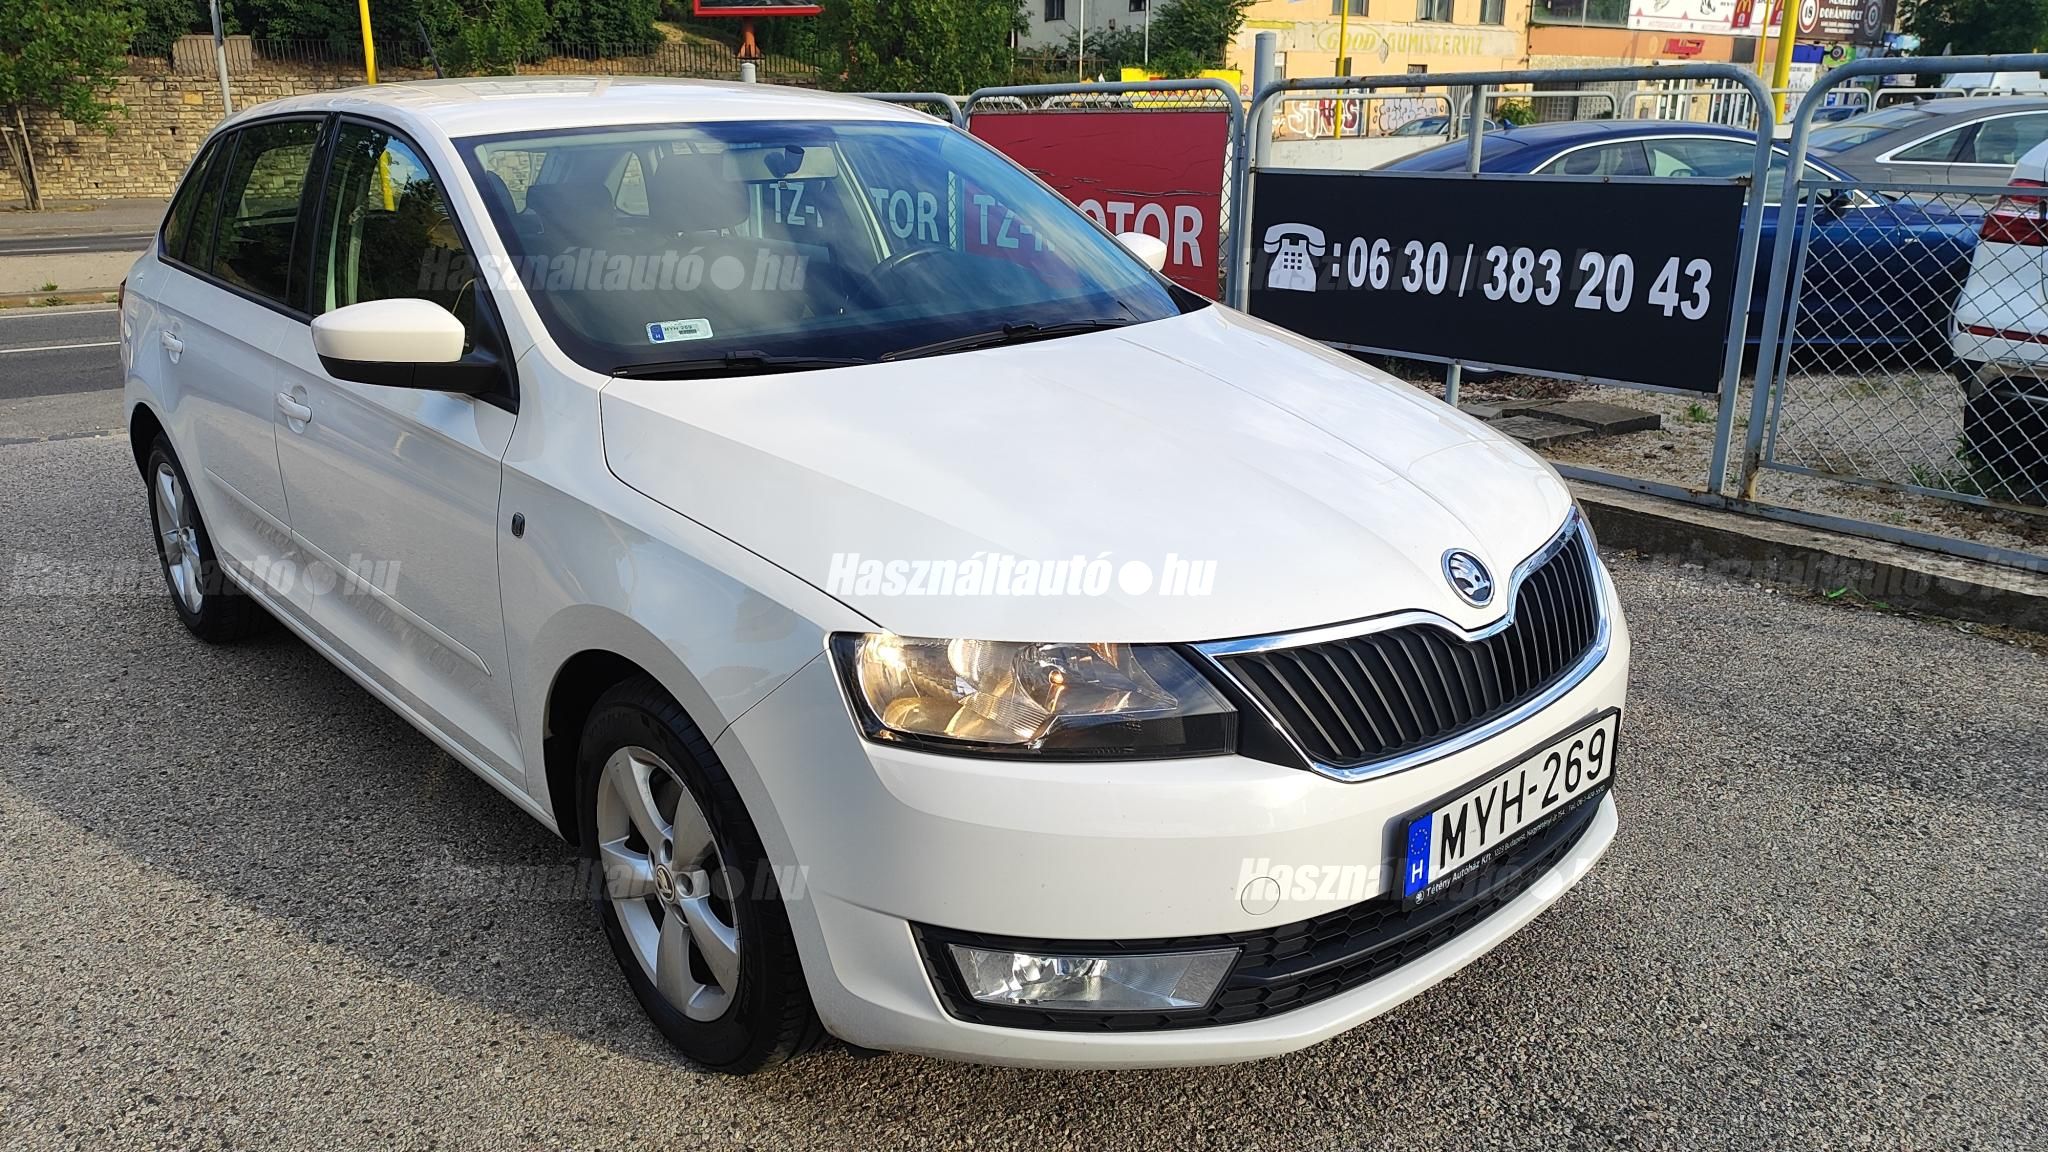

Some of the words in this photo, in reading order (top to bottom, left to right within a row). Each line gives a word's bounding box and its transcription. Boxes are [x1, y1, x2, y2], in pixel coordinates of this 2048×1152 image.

[1402, 240, 1448, 295] 30
[1484, 245, 1562, 306] 383
[1574, 251, 1635, 313] 20
[1648, 256, 1712, 320] 43
[1439, 727, 1606, 871] MYH-269
[1411, 859, 1424, 883] H
[1426, 877, 1451, 897] Tétény
[1452, 860, 1480, 883] Autóház
